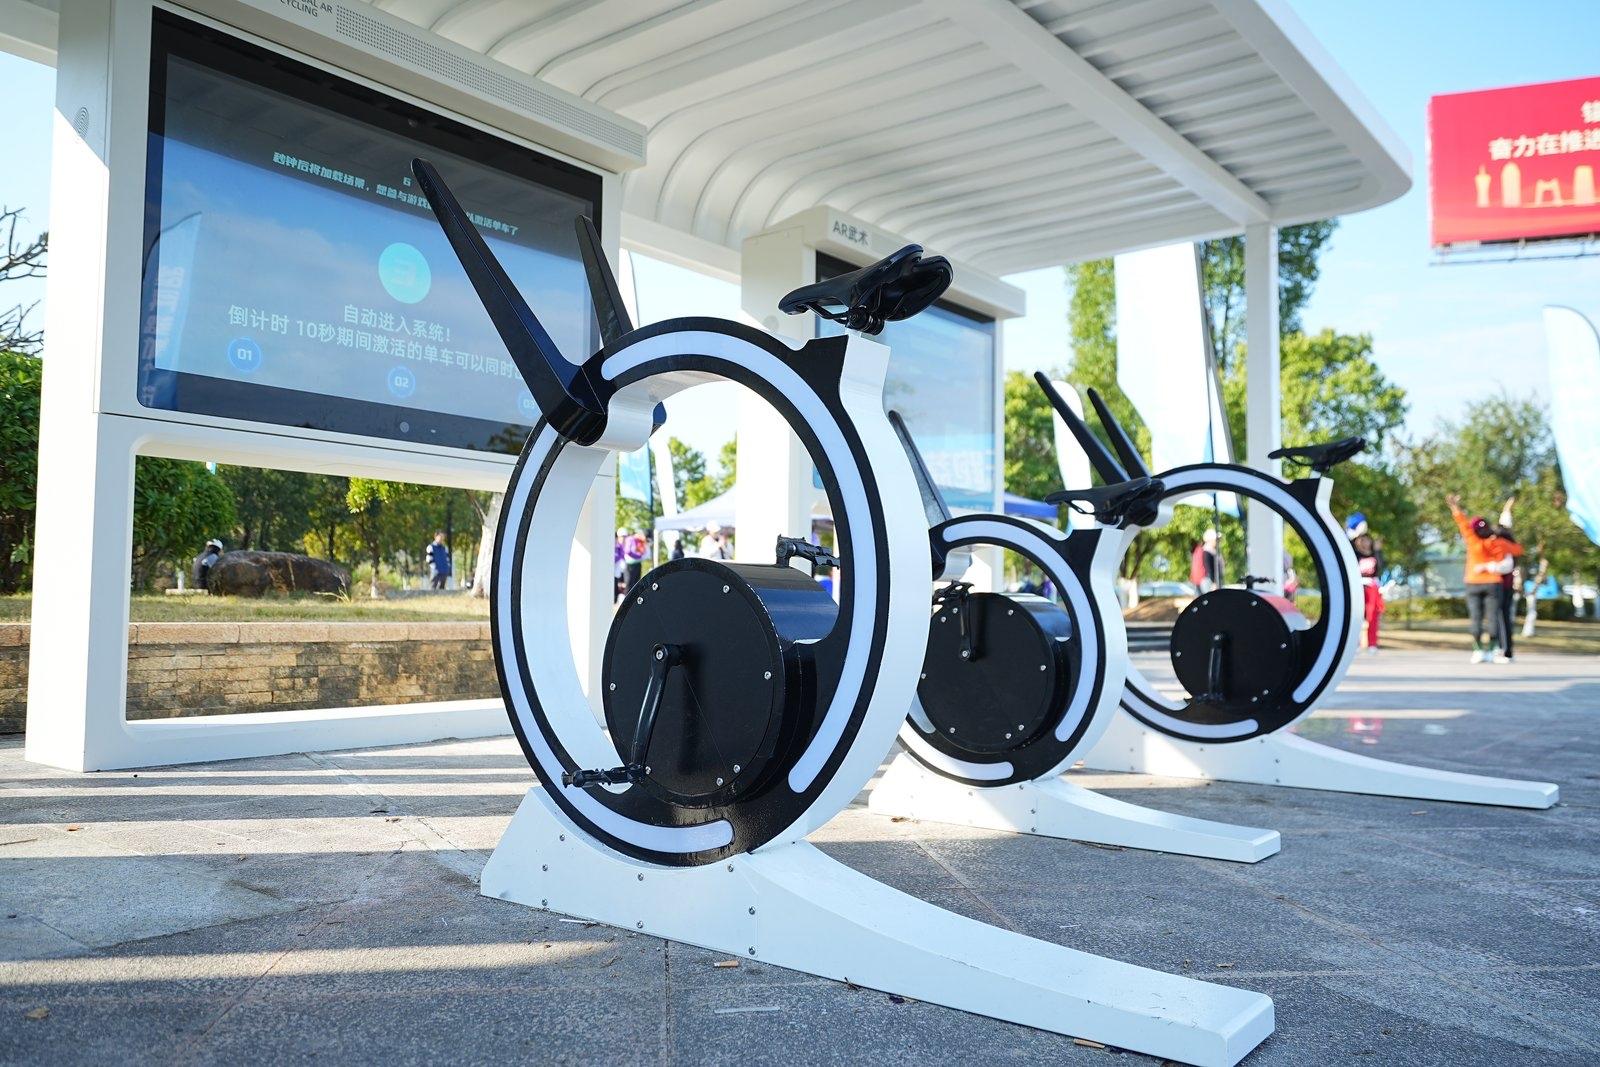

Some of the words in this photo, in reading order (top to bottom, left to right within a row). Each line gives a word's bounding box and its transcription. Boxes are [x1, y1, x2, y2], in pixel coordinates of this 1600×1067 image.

[228, 304, 289, 335] 倒计时
[237, 348, 252, 360] 01
[394, 376, 409, 388] 02
